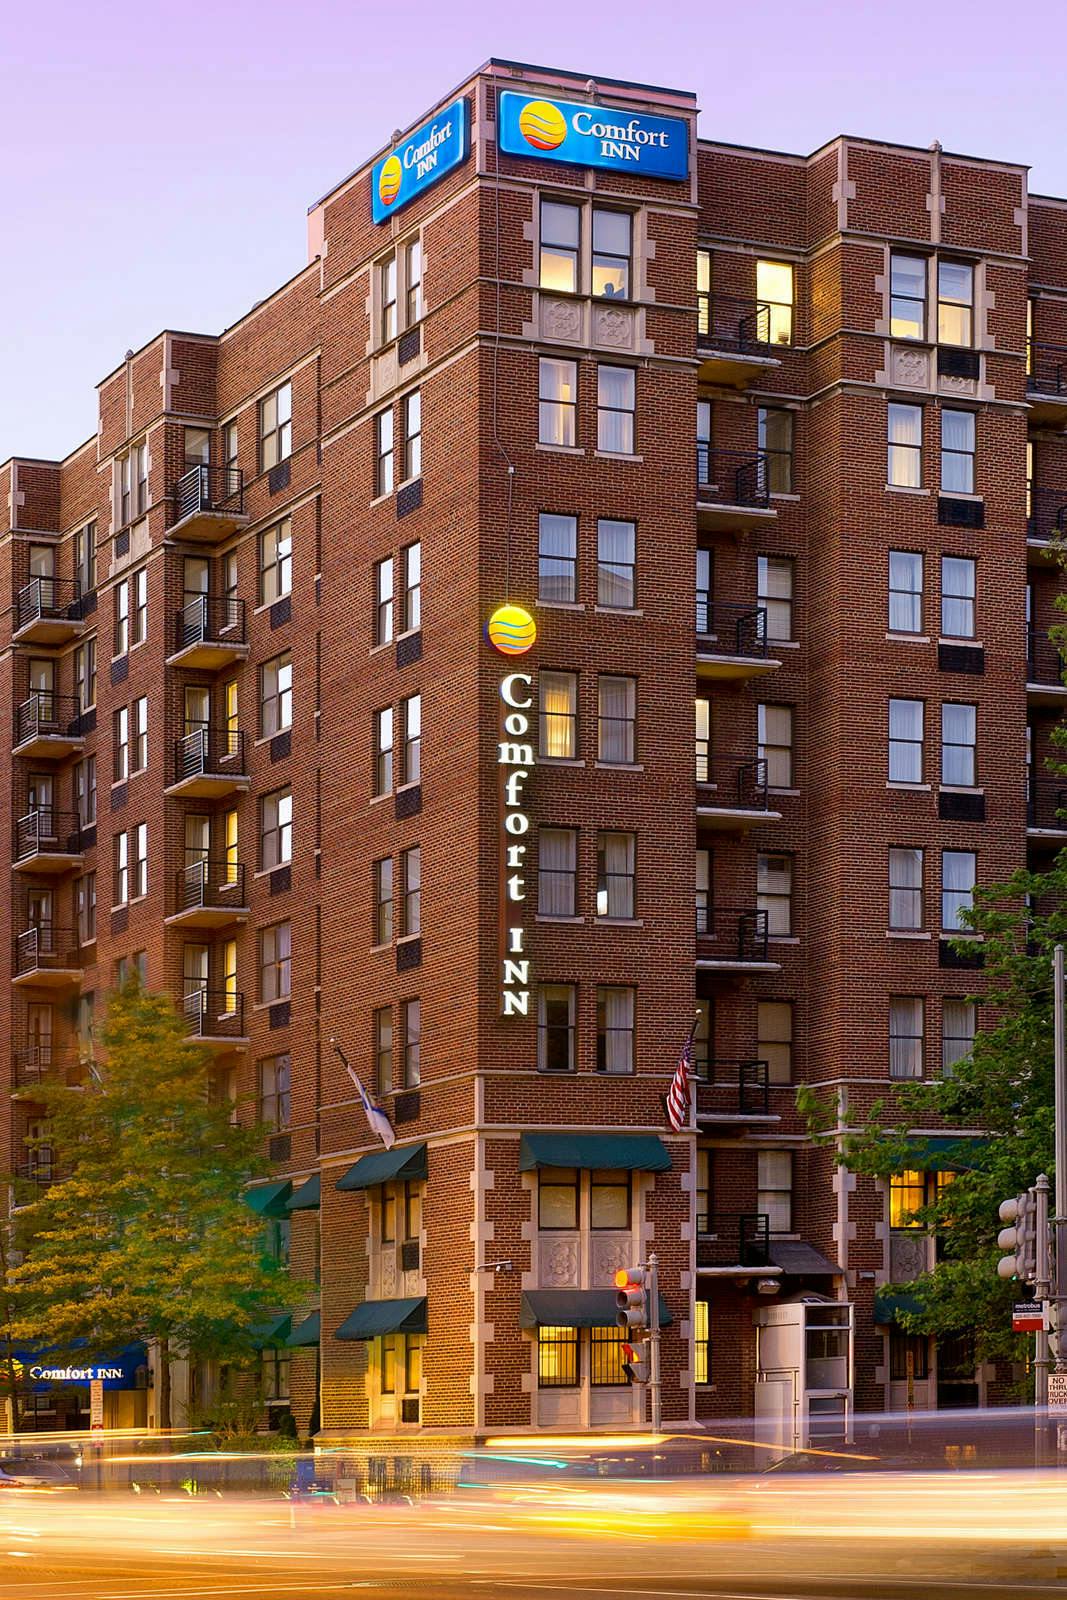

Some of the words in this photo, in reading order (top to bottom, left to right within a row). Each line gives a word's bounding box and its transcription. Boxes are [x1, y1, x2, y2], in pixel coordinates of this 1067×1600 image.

[403, 121, 452, 169] Comfort
[572, 112, 669, 147] Comfort
[417, 150, 438, 180] INN
[601, 141, 640, 160] INN
[498, 673, 535, 901] Comfort
[503, 928, 530, 1016] INN
[30, 1365, 94, 1380] Comfort
[97, 1368, 122, 1379] INN
